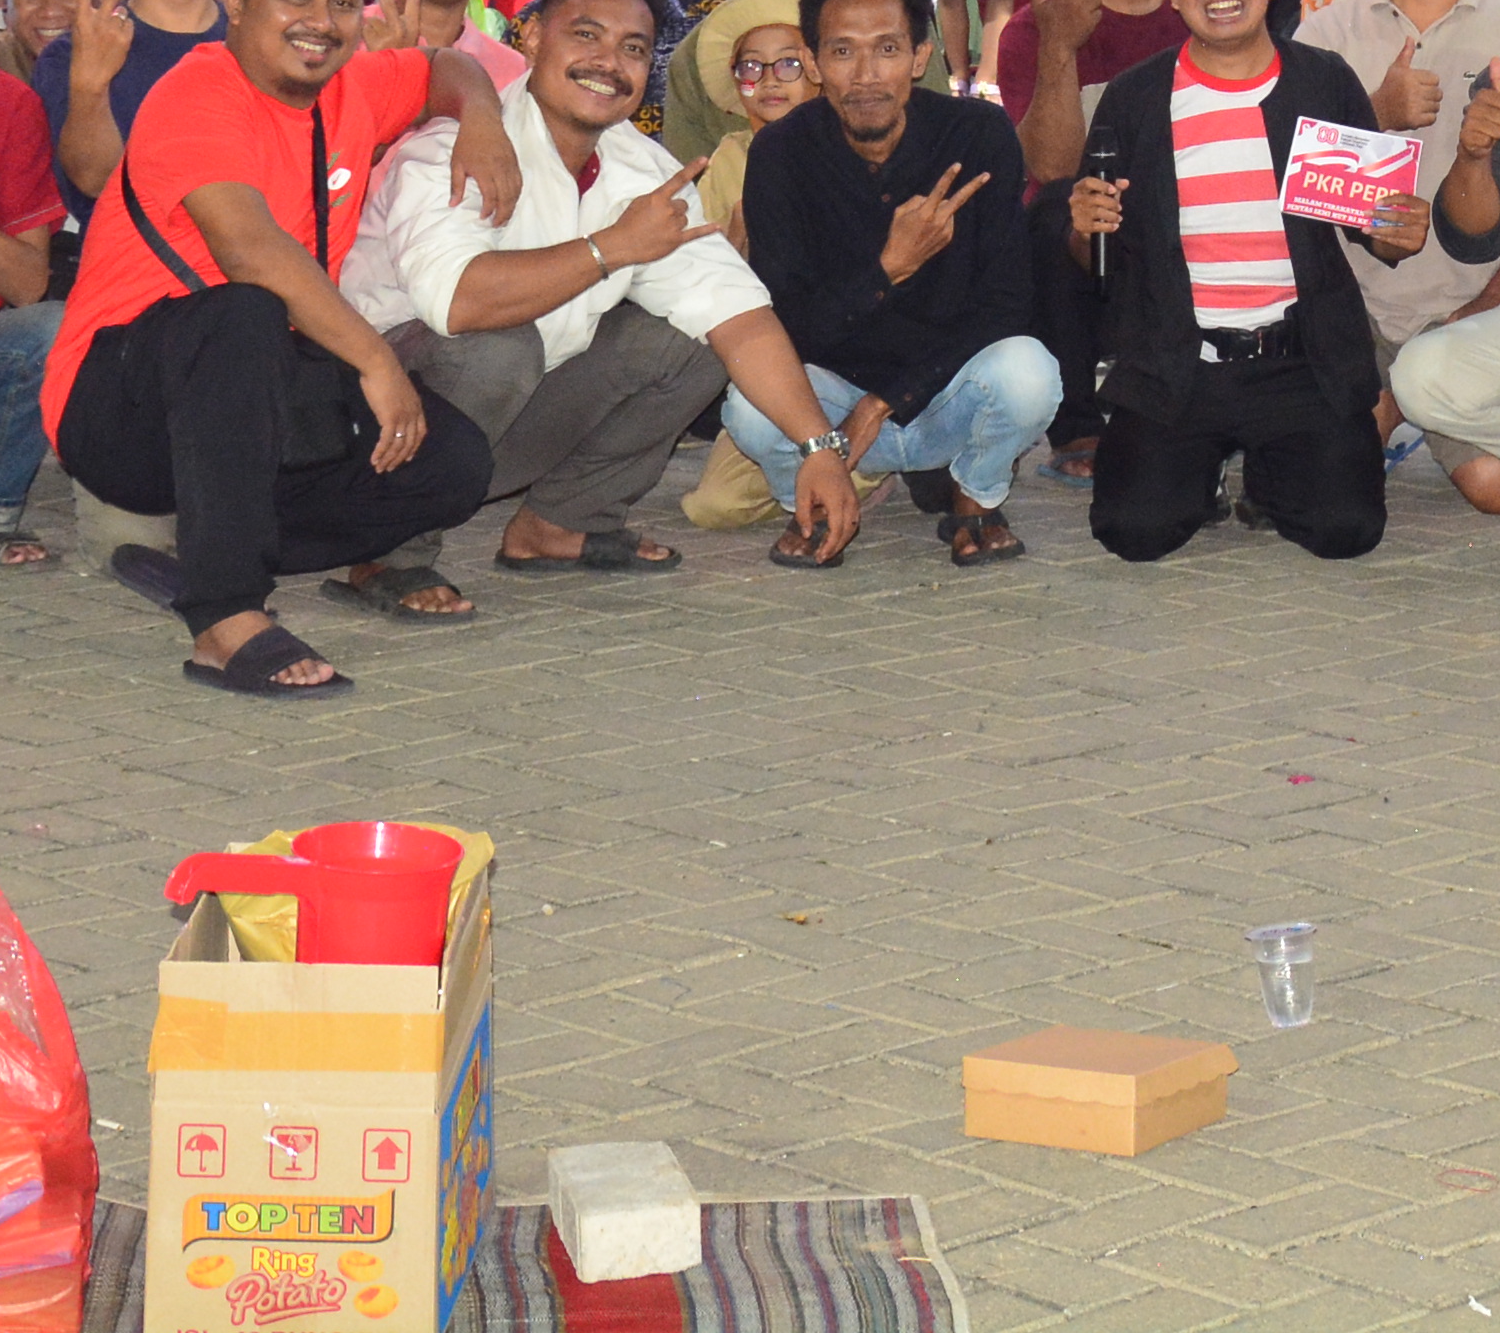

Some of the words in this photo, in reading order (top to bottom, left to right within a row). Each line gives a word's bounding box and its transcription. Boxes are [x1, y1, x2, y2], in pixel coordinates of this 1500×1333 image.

[1317, 126, 1339, 145] 80
[1303, 171, 1345, 196] PKR
[201, 1201, 288, 1232] TOP
[293, 1203, 375, 1234] TEN
[250, 1245, 318, 1278] Ring
[225, 1269, 347, 1326] Potato
